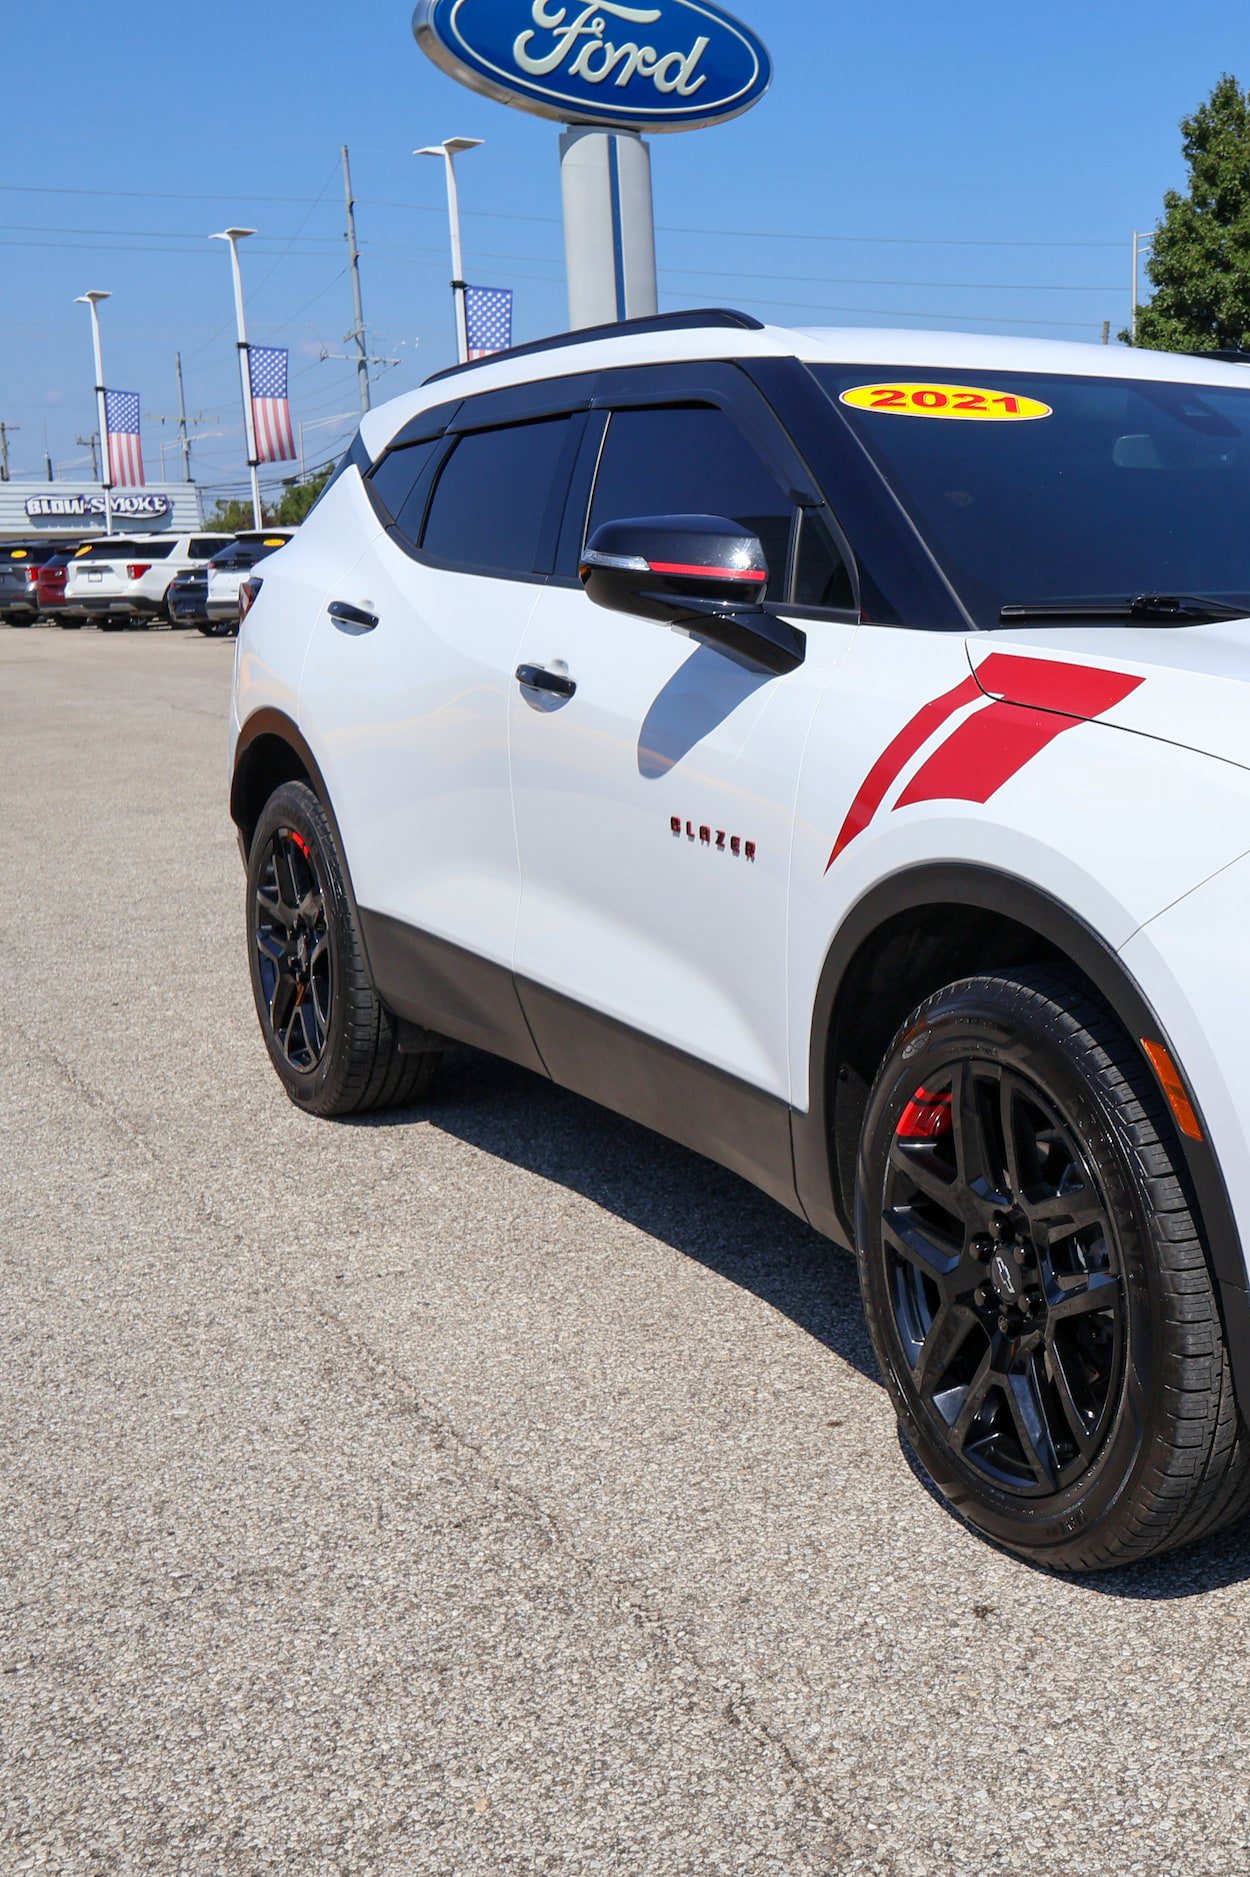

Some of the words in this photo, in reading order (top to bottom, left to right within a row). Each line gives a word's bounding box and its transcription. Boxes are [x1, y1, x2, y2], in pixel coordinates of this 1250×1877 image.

[513, 0, 710, 97] Ford
[870, 388, 1021, 414] 2021
[27, 497, 85, 515] BLOW
[90, 496, 167, 513] SMOKE
[670, 816, 756, 859] BLAZER
